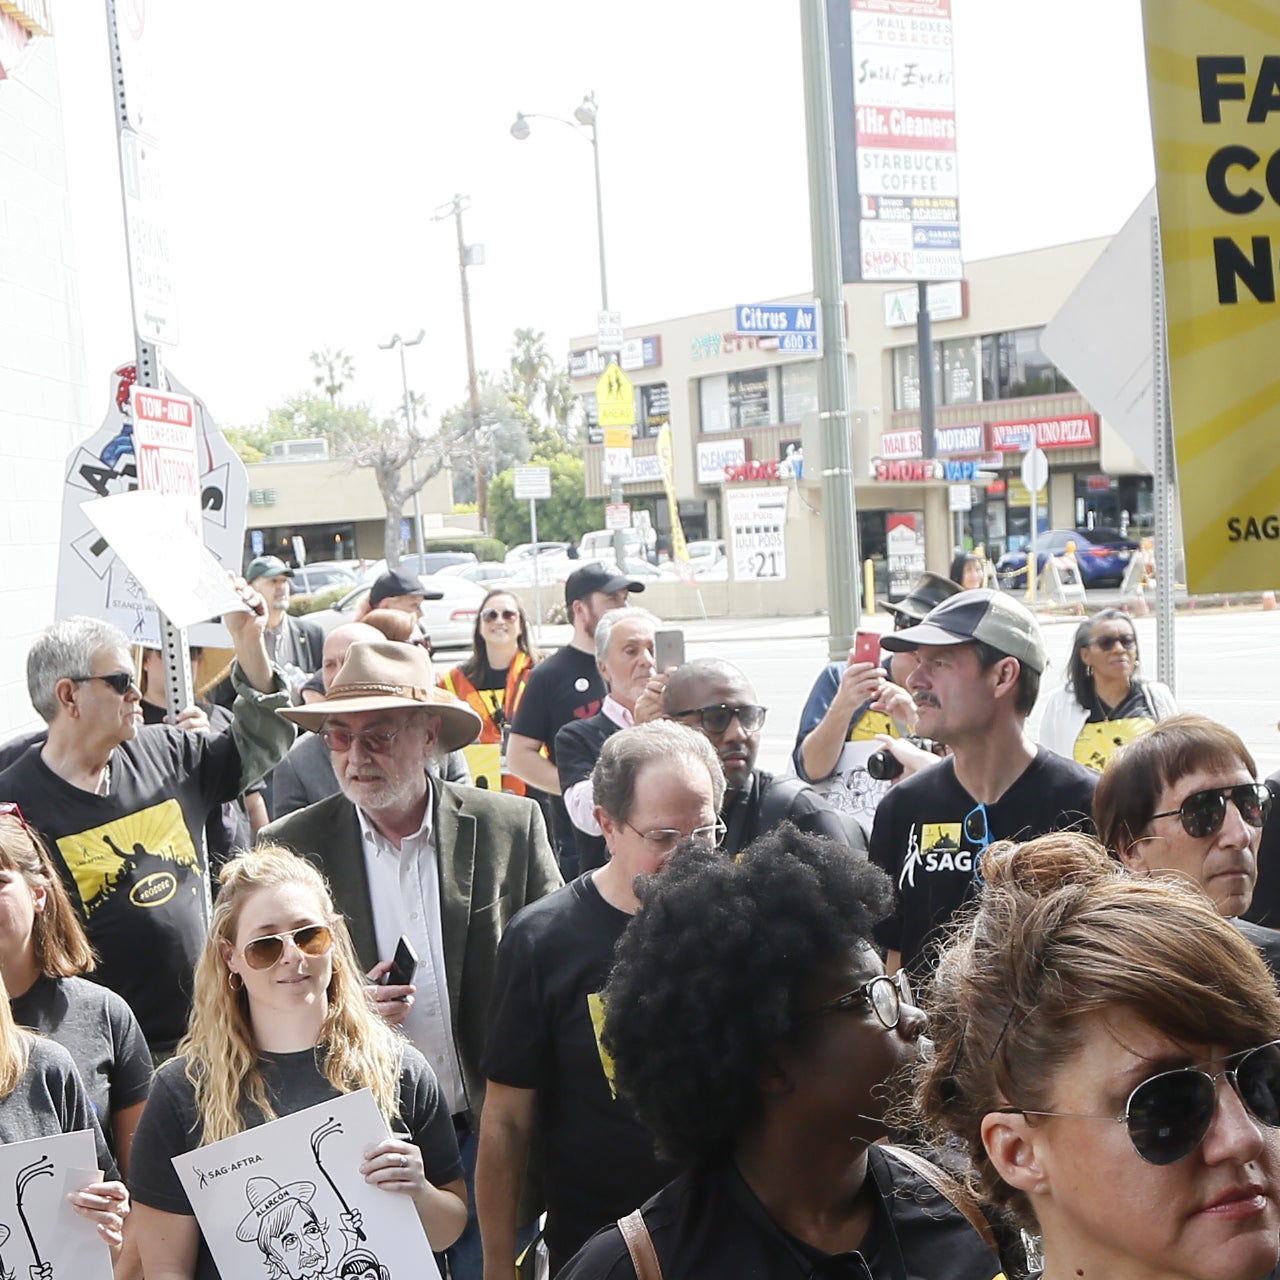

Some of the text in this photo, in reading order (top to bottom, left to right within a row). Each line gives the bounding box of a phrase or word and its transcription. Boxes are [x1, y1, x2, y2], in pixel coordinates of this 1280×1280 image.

[876, 30, 952, 46] TOBACCO
[890, 109, 956, 139] Cleaners
[863, 153, 953, 172] STARBUCKS
[881, 173, 938, 191] COFFEE
[879, 207, 957, 221] MUSIC ACADEMY
[741, 306, 813, 330] Citrus Av
[783, 335, 803, 349] 600
[806, 335, 813, 349] S
[140, 396, 189, 422] TOW-AWAY
[937, 426, 981, 450] NOTARY
[1037, 419, 1092, 444] UNO PIZZA
[884, 434, 908, 453] MAIL
[701, 449, 744, 472] CLEANERS
[724, 460, 779, 482] SMOKE
[876, 459, 980, 480] SMOKE VAPE
[758, 534, 782, 547] PODS
[207, 1154, 263, 1180] SAG·AFTRA
[255, 1190, 291, 1219] ALARCÓN
